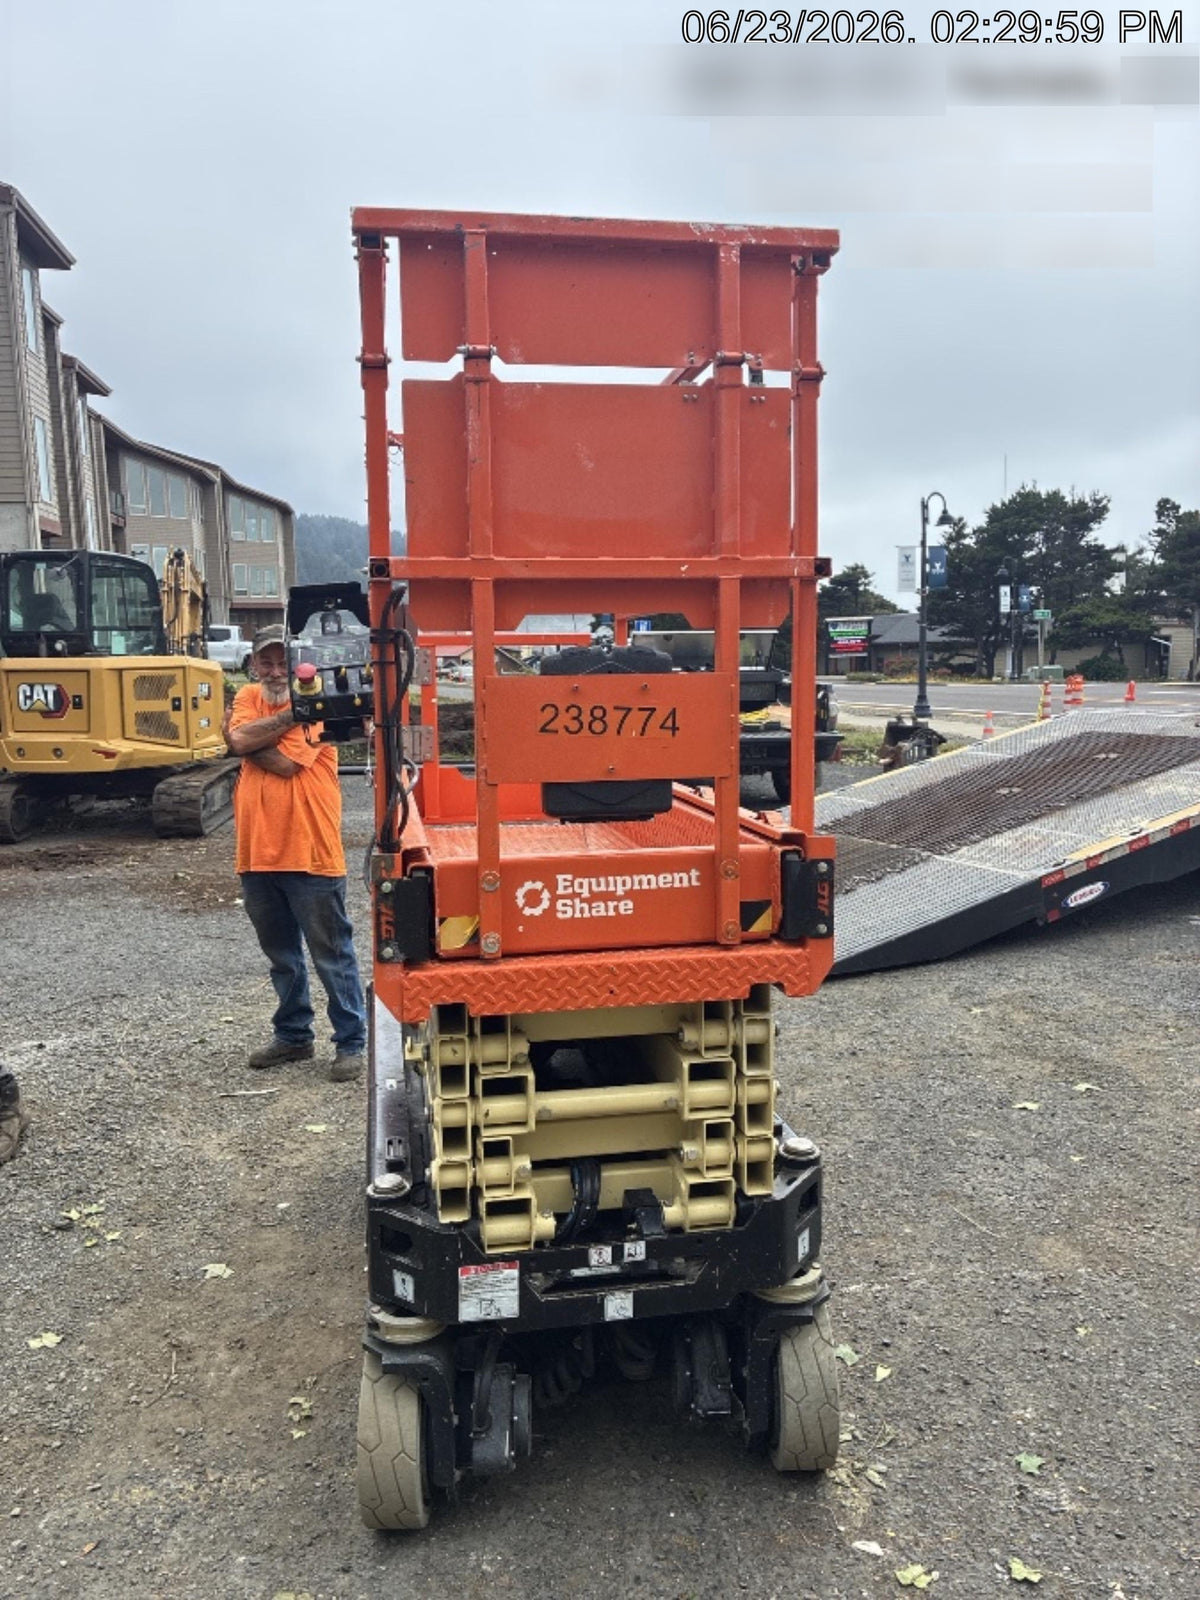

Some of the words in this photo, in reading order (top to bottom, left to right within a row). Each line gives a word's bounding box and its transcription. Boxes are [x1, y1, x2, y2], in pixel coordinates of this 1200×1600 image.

[18, 684, 57, 711] CAT
[538, 703, 680, 737] 238774
[556, 868, 701, 898] Equipment
[556, 897, 634, 920] Share
